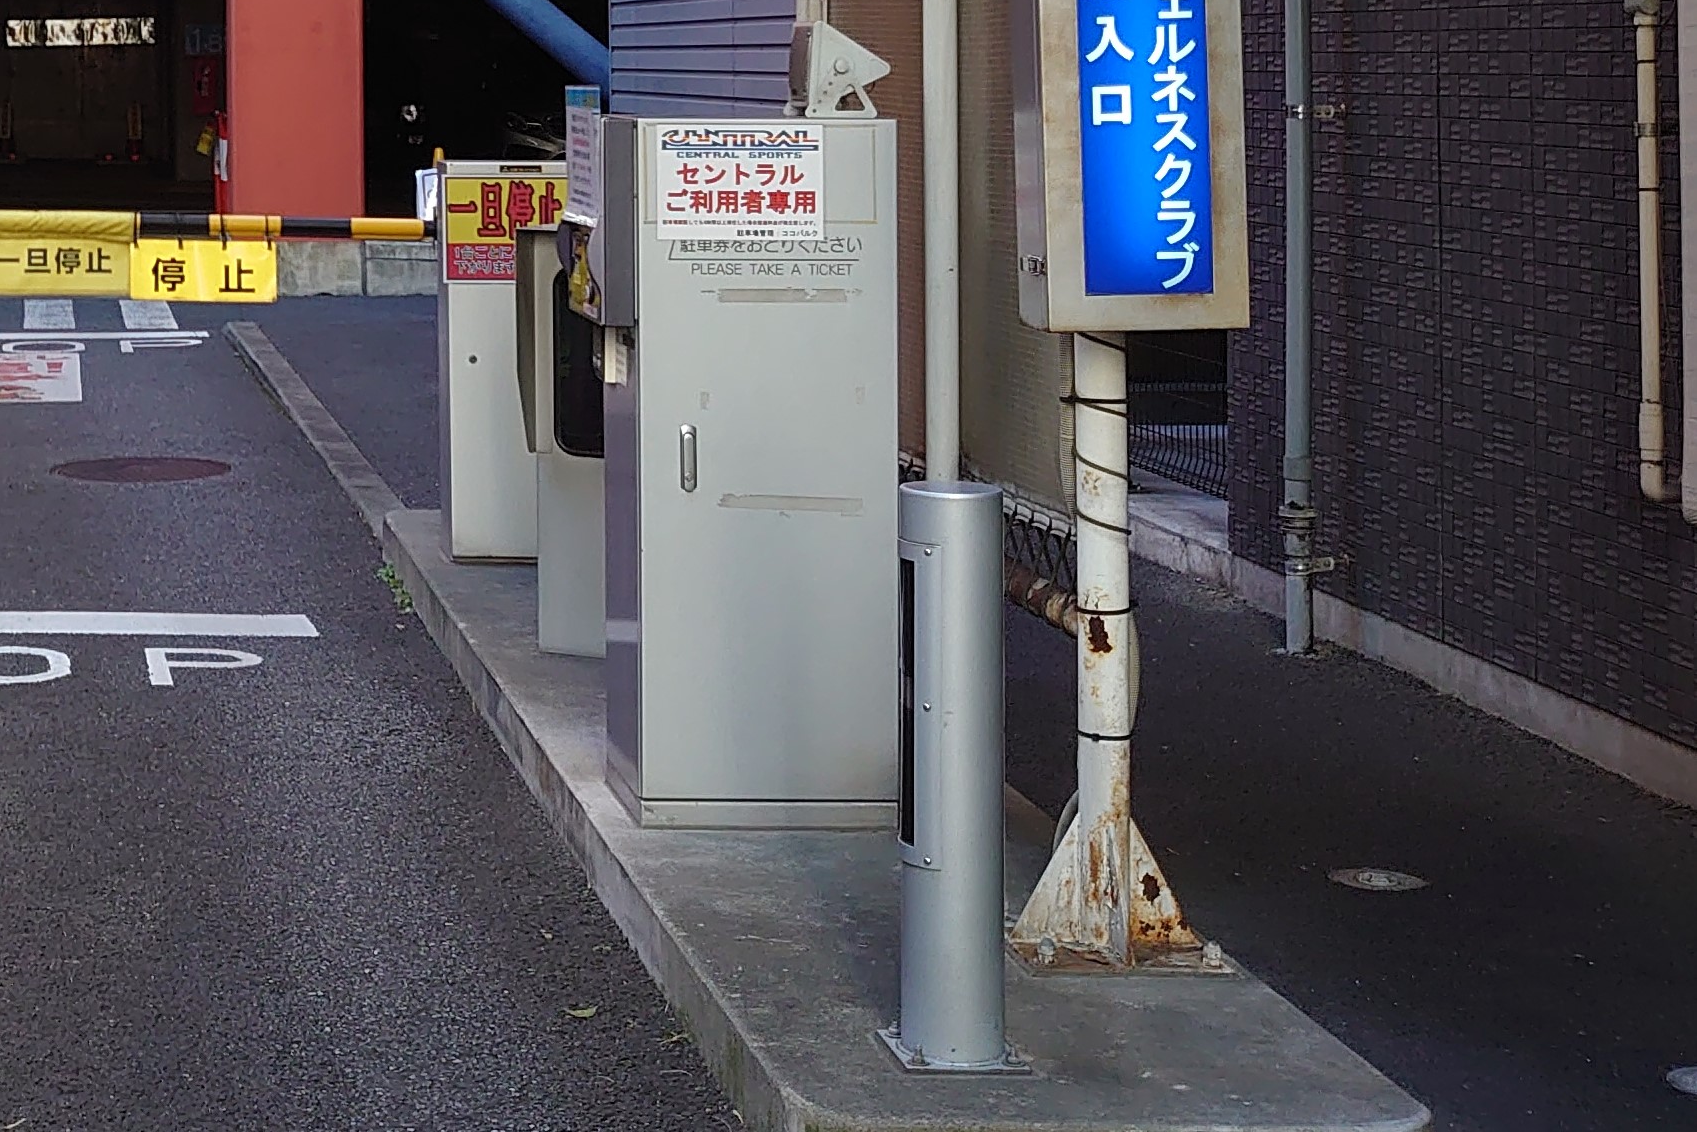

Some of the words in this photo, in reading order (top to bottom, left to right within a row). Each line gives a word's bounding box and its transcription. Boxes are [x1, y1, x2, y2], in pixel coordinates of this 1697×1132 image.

[662, 128, 819, 150] CENTRAL
[676, 151, 739, 159] CENTRAL
[748, 151, 802, 159] SPORTS
[676, 163, 804, 187] セントラル
[666, 188, 817, 214] ご利用者専用
[454, 245, 515, 260] 1台ごとに
[151, 258, 255, 294] 停止
[691, 264, 742, 276] PLEASE
[751, 264, 784, 276] TAKE
[790, 264, 802, 276] A
[809, 264, 853, 276] TICKET
